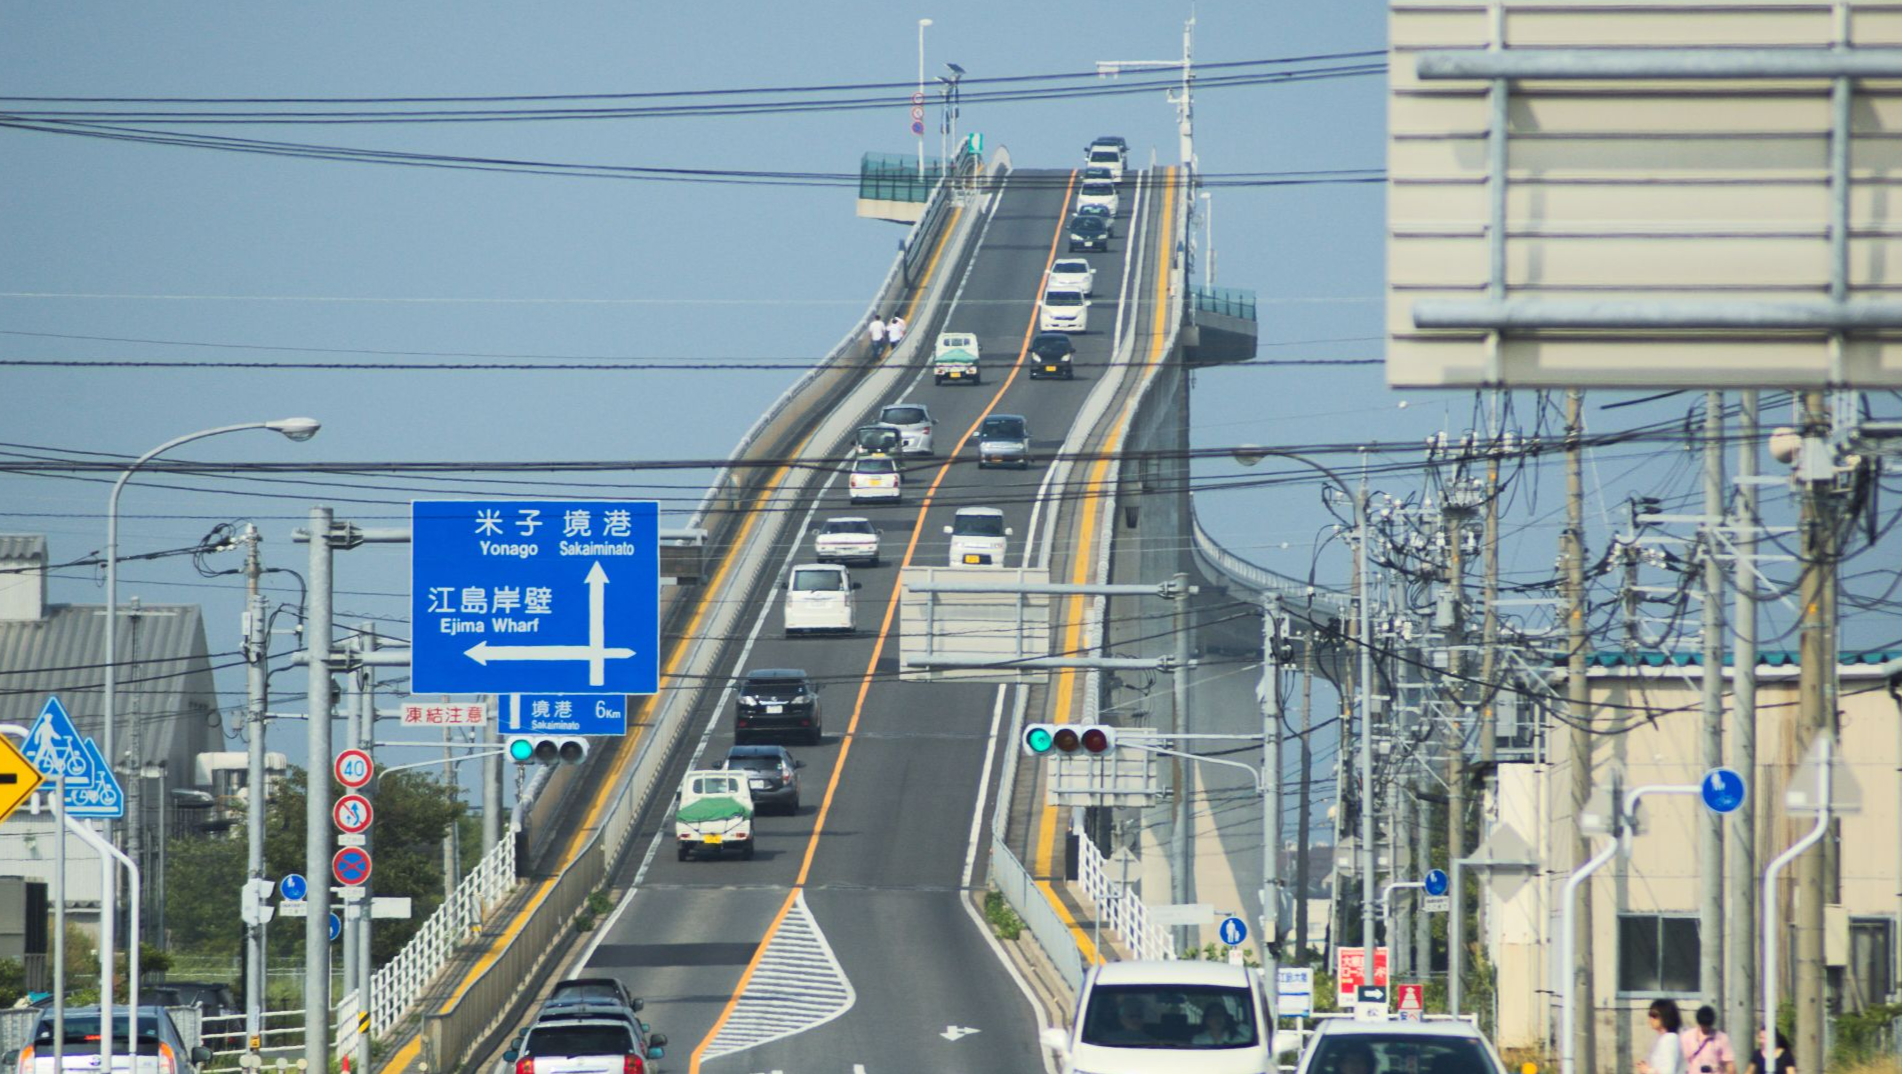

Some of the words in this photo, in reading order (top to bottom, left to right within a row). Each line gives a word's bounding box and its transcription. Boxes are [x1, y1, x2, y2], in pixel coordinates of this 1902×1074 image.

[474, 508, 543, 537] 米子
[562, 509, 632, 538] 境港
[479, 540, 539, 559] Yonago
[559, 540, 635, 556] Sakaiminato
[427, 585, 553, 614] 江島岸壁
[440, 617, 485, 636] Ejima
[491, 617, 540, 633] Wharf
[404, 706, 484, 724] 凍結注意
[531, 700, 573, 719] 境港
[530, 719, 581, 731] Sakaiminato
[343, 760, 365, 777] 40
